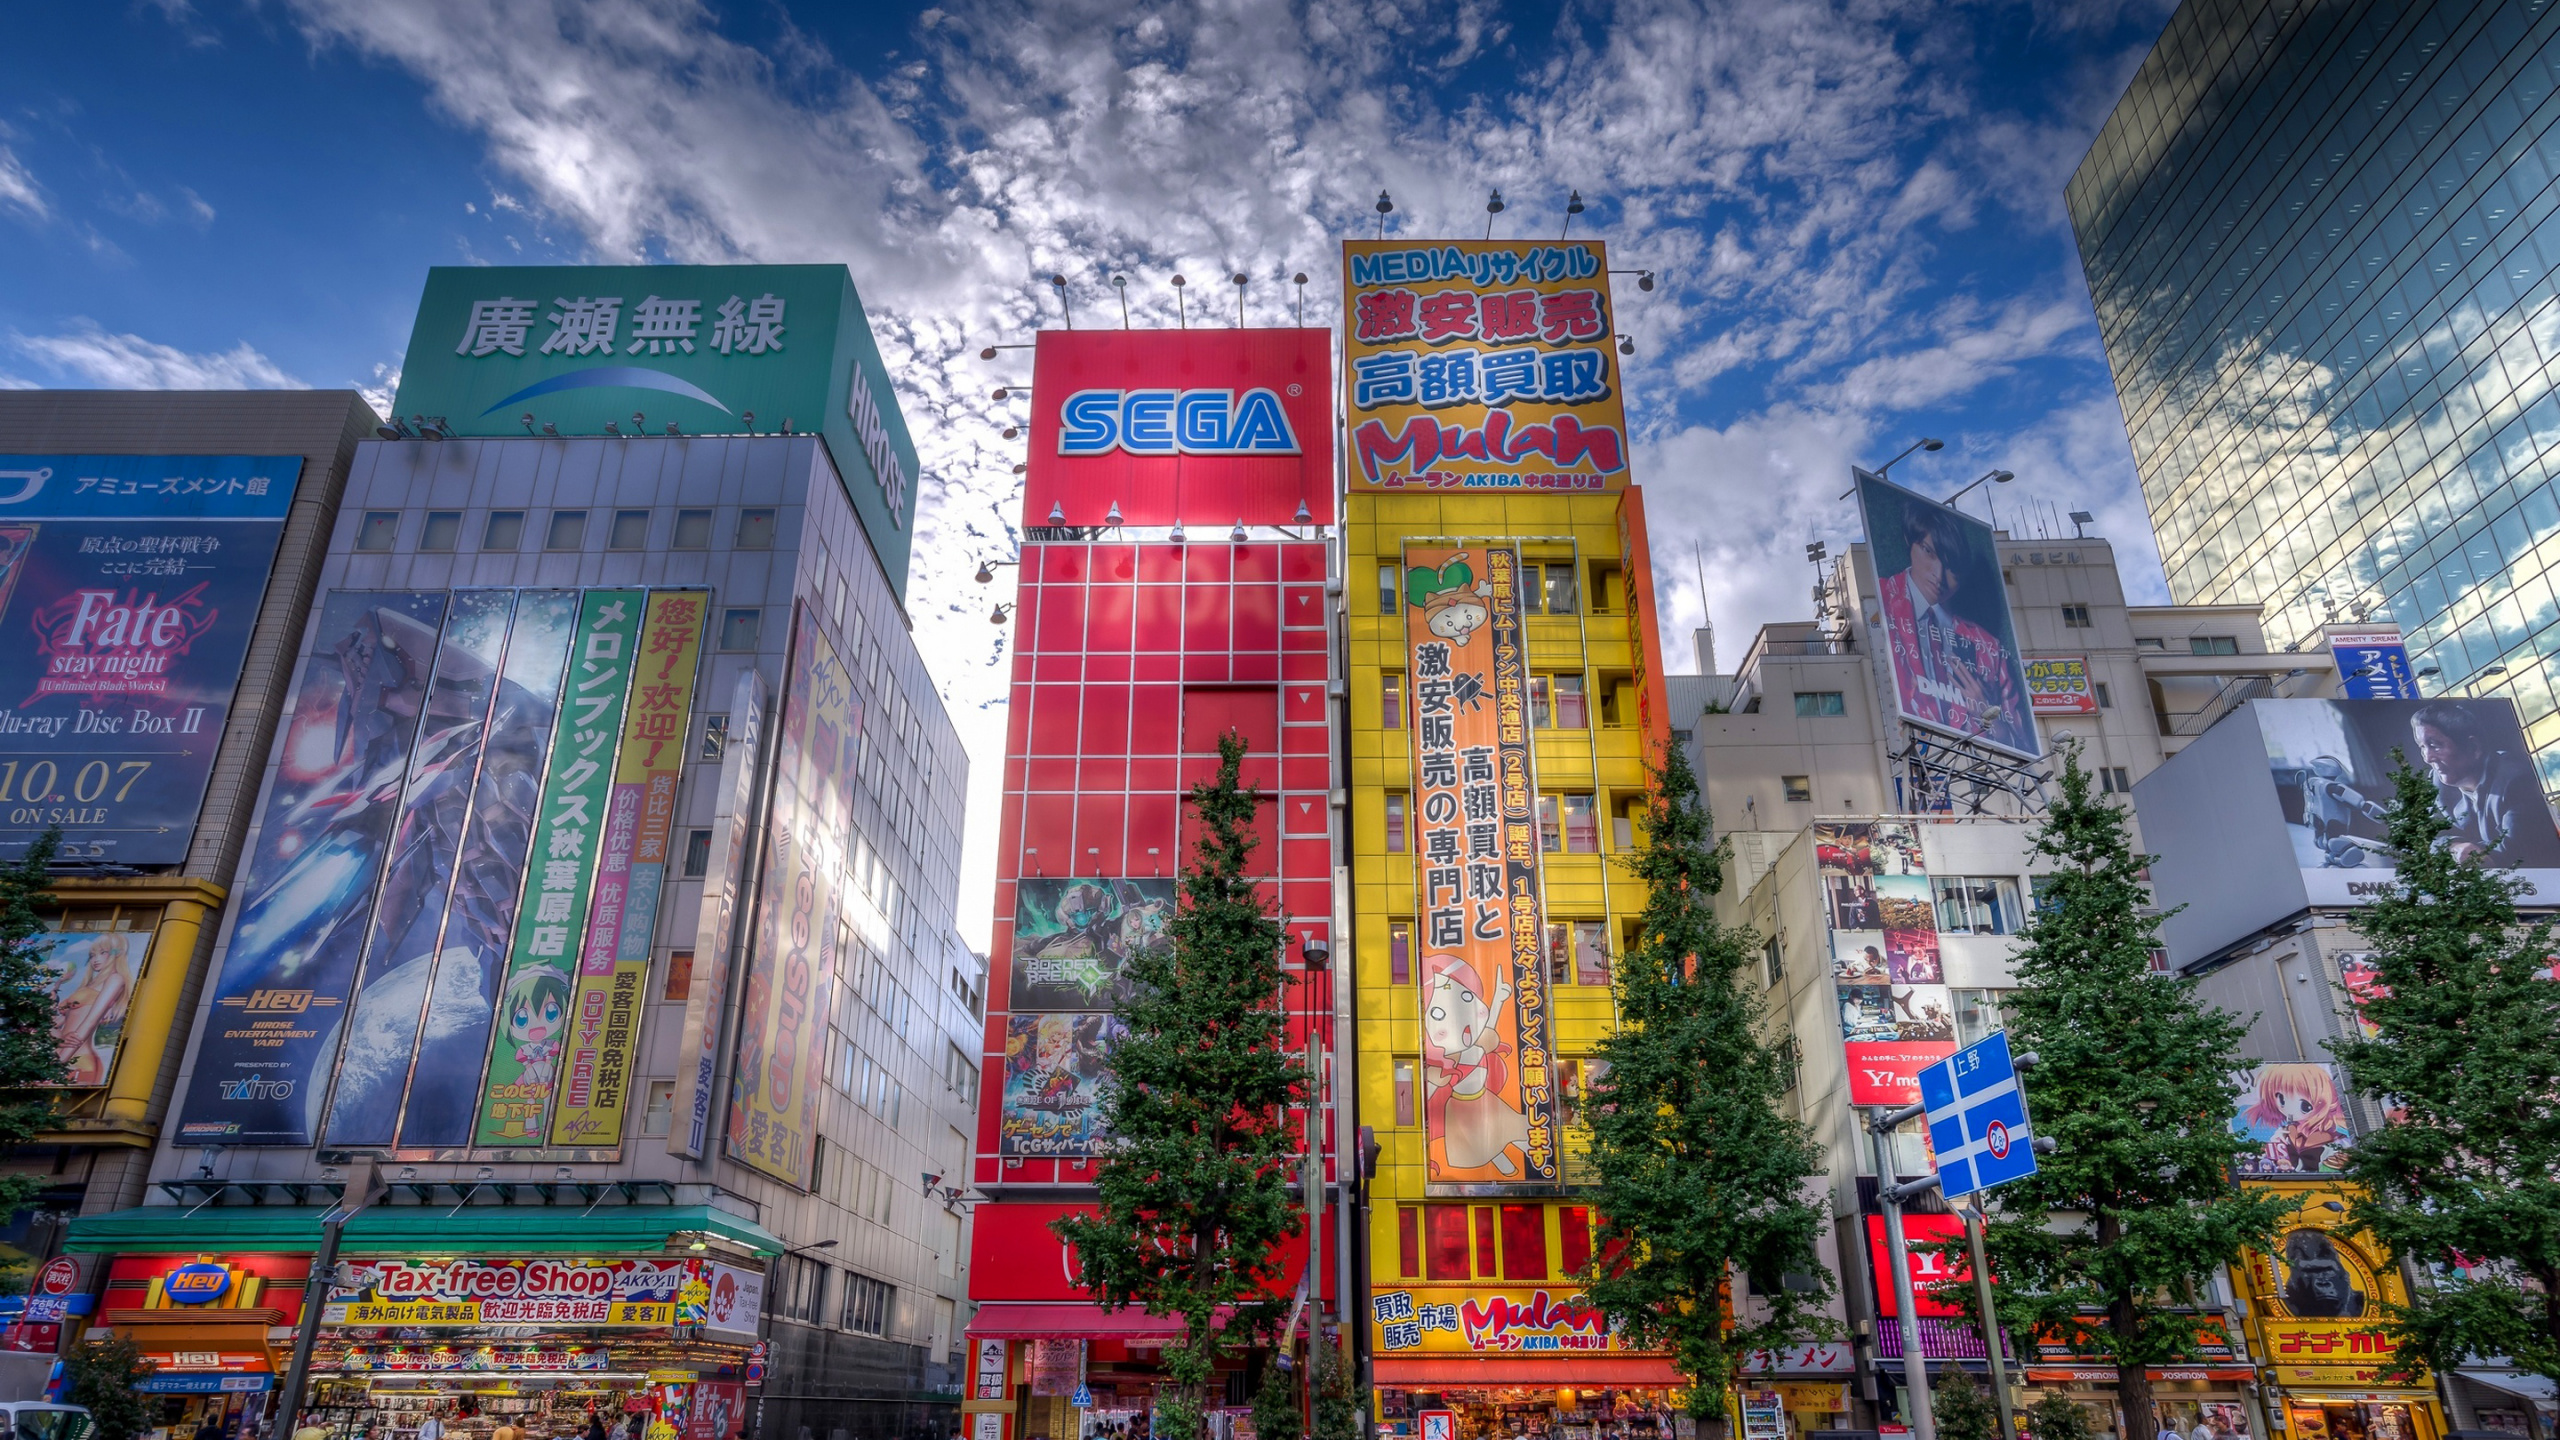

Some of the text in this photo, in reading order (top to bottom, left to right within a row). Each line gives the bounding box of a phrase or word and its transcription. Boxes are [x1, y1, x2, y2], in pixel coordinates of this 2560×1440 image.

[1352, 246, 1598, 287] MEDIAリサイクル
[455, 293, 787, 357] 廣瀬無線
[1355, 291, 1602, 343] 激安販売
[1354, 347, 1605, 406] 高額買取
[1059, 388, 1302, 456] SEGA
[848, 359, 906, 531] HIROSE
[1354, 406, 1626, 486] Mulan
[73, 475, 272, 497] アミューズメント館
[1384, 471, 1605, 490] ムーラン AKIBA 中央通り店
[78, 535, 221, 555] 原点の聖杯戦争
[63, 591, 182, 648] Fate
[2371, 635, 2399, 643] DREAM
[52, 650, 167, 680] stay night
[99, 680, 128, 693] Blade
[1916, 675, 1966, 707] DMM
[72, 709, 124, 734] Disc
[128, 708, 176, 734] Box
[0, 760, 152, 803] 10.07
[528, 599, 627, 957] メロンブックス秋葉原店
[1416, 642, 1465, 949] 激安販売の専門店
[10, 807, 108, 824] ON SALE
[639, 775, 673, 859] 货比三家
[1460, 745, 1505, 941] 高額買取と
[587, 788, 640, 971] 价格优惠 优质服务
[623, 868, 656, 956] 安心购物
[1020, 956, 1100, 971] BORDER
[244, 990, 315, 1013] Hey
[252, 1021, 295, 1030] HIROSE
[578, 990, 607, 1047] DUTY
[223, 1030, 319, 1039] ENTERTAINMENT
[252, 1038, 285, 1047] YARD
[768, 951, 812, 1115] Shop
[234, 1061, 292, 1069] PRESENTED BY
[1956, 1048, 1981, 1078] 上野
[490, 1083, 551, 1100] このビル
[566, 1049, 598, 1108] FREE
[490, 1102, 544, 1120] 地下1F
[1002, 1118, 1073, 1139] ゲーセンで
[169, 1272, 226, 1294] Hey
[378, 1263, 518, 1292] Tax-free
[525, 1263, 614, 1297] Shop
[617, 1274, 665, 1288] AKKY
[353, 1305, 475, 1321] 海外向け電気製品
[482, 1300, 609, 1321] 歓迎光臨免税店
[743, 1311, 758, 1326] Shop
[1373, 1292, 1414, 1322] 買取
[1418, 1303, 1459, 1331] 市場
[1384, 1320, 1421, 1349] 販売
[1472, 1334, 1609, 1351] ムーラン AKIBA 中央通り店
[2279, 1329, 2405, 1354] ゴーゴーカレ
[173, 1351, 220, 1367] Hey
[384, 1353, 431, 1364] Tax-free
[432, 1353, 461, 1365] Shop
[1753, 1347, 1838, 1369] ラーメン
[2161, 1371, 2209, 1381] YOSHINOYA
